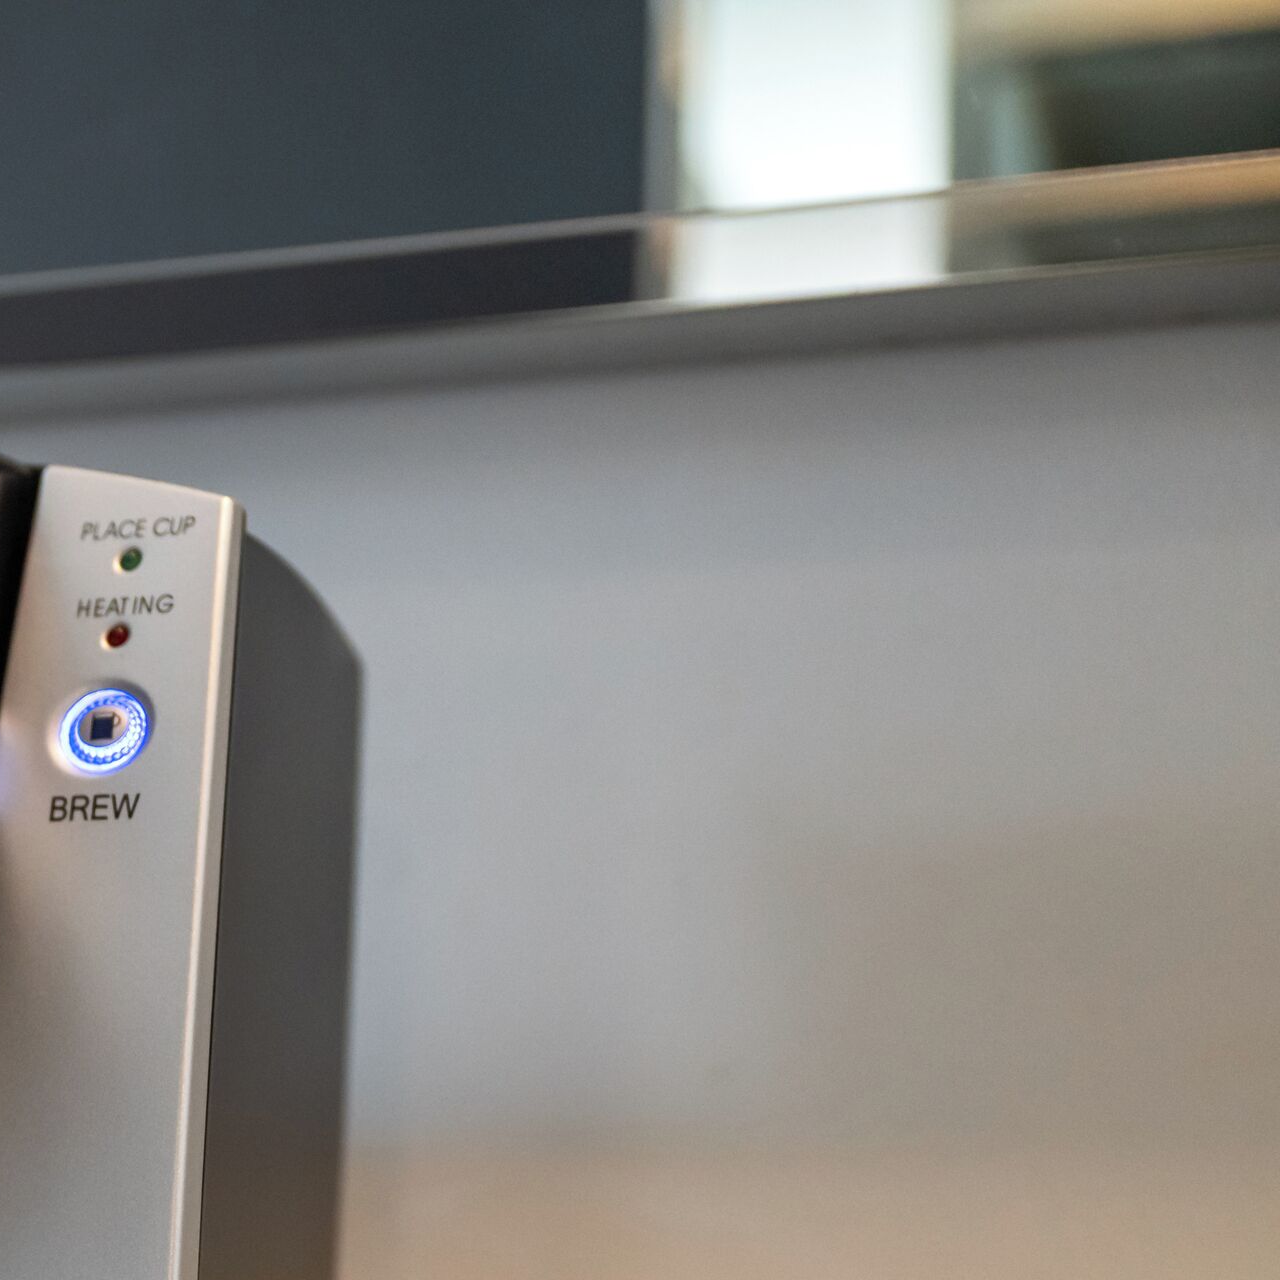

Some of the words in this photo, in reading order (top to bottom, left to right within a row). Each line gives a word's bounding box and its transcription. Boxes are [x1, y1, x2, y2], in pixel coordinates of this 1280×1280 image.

[81, 518, 146, 540] PLACE
[153, 515, 196, 536] CUP
[76, 594, 174, 617] HEATING
[49, 793, 140, 822] BREW
